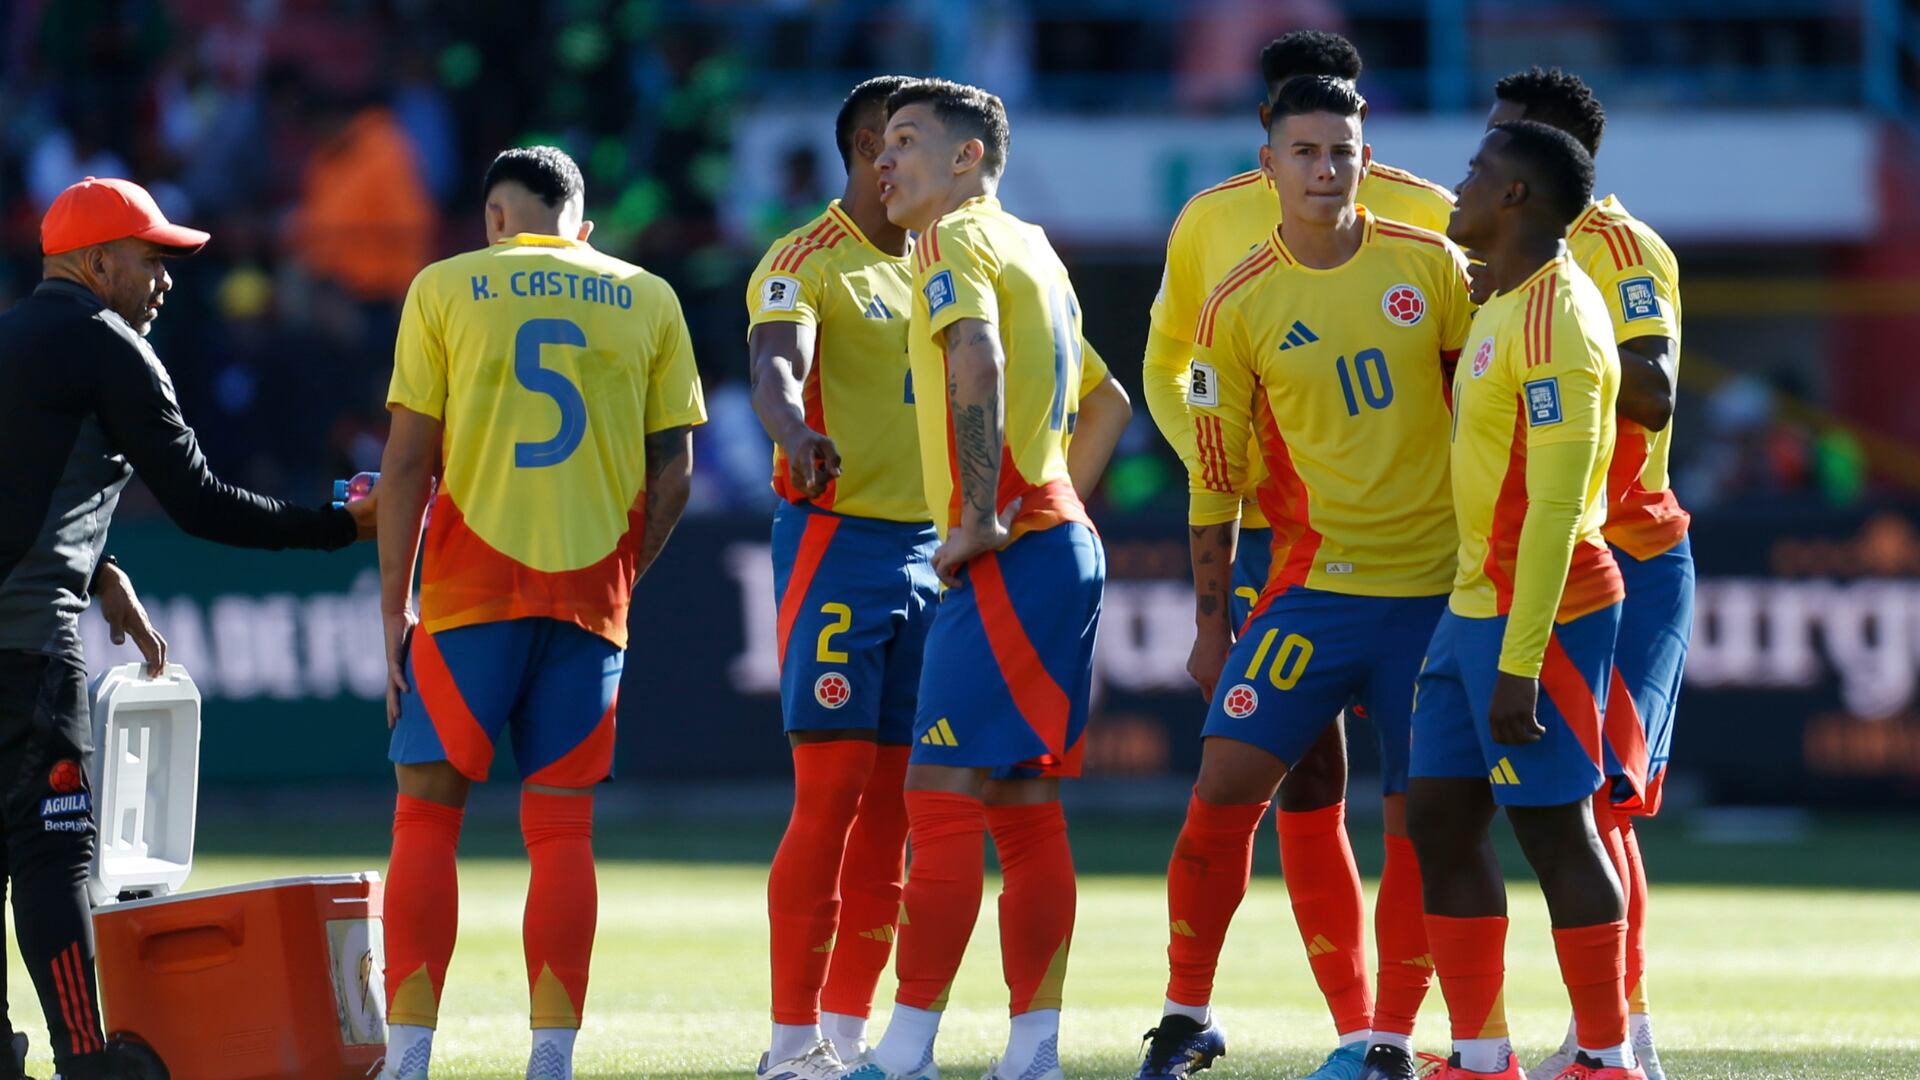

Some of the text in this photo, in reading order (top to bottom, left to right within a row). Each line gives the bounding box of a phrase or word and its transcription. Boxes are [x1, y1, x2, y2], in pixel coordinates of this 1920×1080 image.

[471, 271, 632, 310] K. CASTAÑO
[514, 318, 587, 468] 5
[1335, 347, 1394, 417] 10
[816, 602, 852, 664] 2
[1244, 627, 1315, 691] 10
[42, 795, 87, 815] AGUILA
[44, 820, 88, 833] BetPlay
